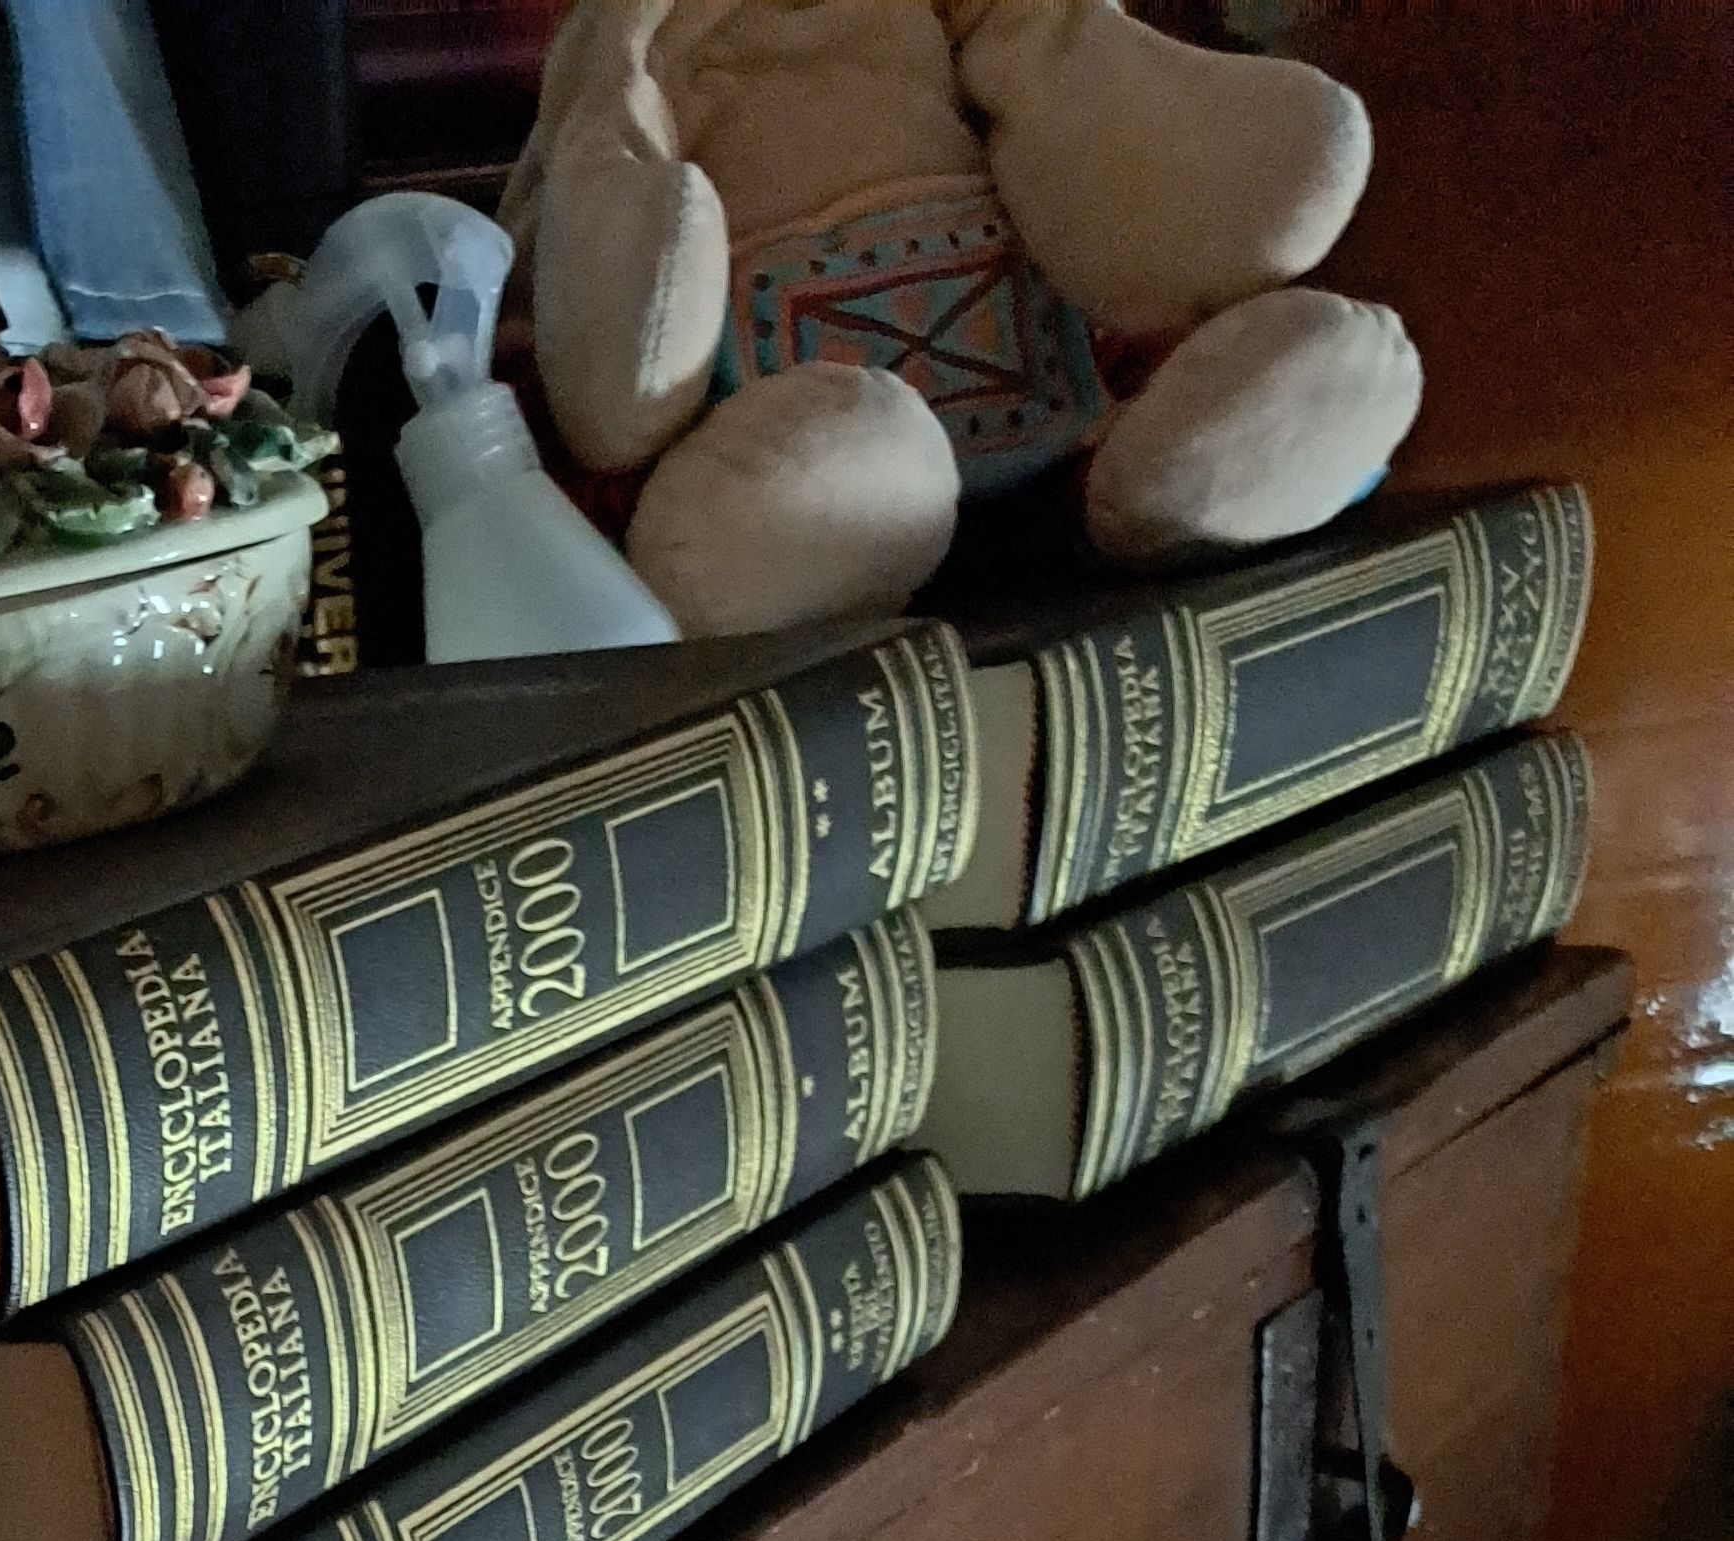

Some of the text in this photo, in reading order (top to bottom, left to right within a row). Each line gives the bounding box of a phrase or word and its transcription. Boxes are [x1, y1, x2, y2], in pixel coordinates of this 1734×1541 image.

[856, 686, 900, 881] ALBUM
[471, 857, 516, 1032] APPENDICE
[506, 836, 587, 1019] 2000
[115, 928, 196, 1238] ENCICLOPEDIA
[171, 951, 234, 1184] ITALIANA
[837, 964, 872, 1142] ALBUM
[514, 1156, 550, 1314] APPENDICE
[543, 1132, 610, 1298] 2000
[211, 1247, 283, 1532] ENCICLOPEDIA
[261, 1265, 314, 1480] ITALIANA
[583, 1414, 647, 1541] 2000
